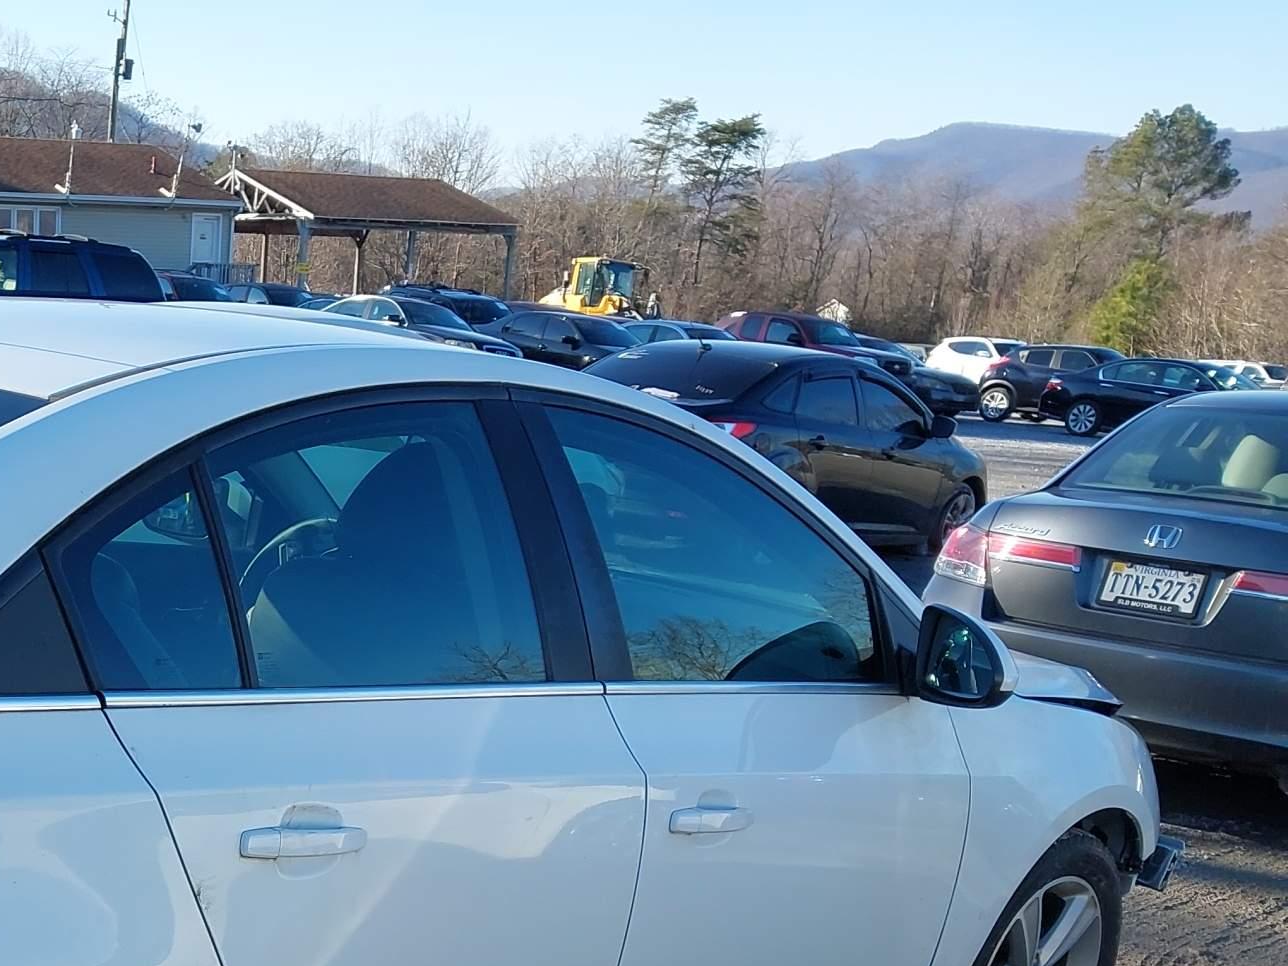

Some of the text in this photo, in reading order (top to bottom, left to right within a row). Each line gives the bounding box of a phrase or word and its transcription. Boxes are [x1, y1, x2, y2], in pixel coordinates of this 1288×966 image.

[1134, 564, 1180, 579] VIRGINIA
[1108, 571, 1199, 604] TTN-5273
[1159, 604, 1173, 613] LLC
